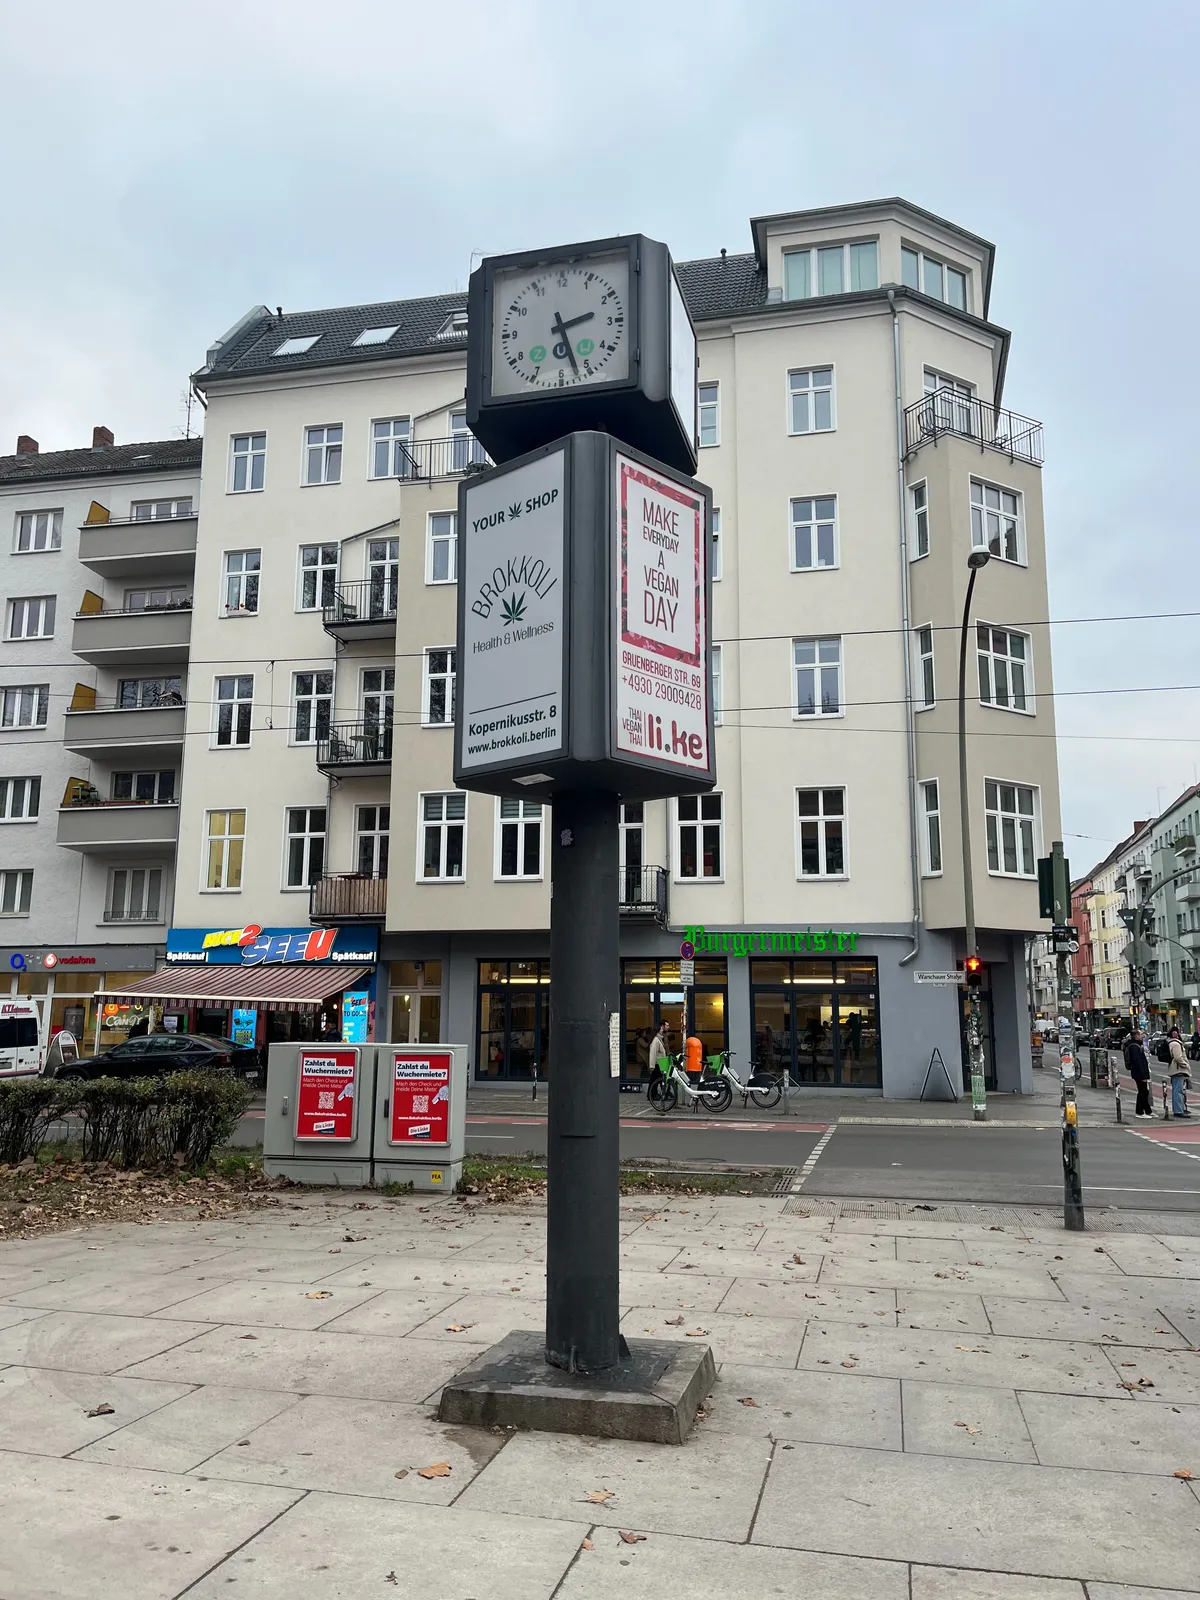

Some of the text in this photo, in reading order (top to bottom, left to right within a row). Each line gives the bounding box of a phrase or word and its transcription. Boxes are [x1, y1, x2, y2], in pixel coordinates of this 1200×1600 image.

[556, 278, 568, 288] 12
[584, 281, 588, 290] 1
[536, 288, 545, 297] 11
[601, 296, 608, 305] 2
[518, 308, 527, 317] 10
[606, 316, 613, 326] 3
[512, 330, 518, 340] 9
[556, 344, 566, 356] U
[600, 340, 606, 349] 4
[518, 352, 524, 360] 8
[534, 349, 543, 360] Z
[584, 359, 590, 368] 5
[534, 366, 540, 376] 7
[558, 369, 564, 378] 6
[472, 488, 558, 533] YOUR SHOP
[643, 497, 680, 538] MAKE
[642, 525, 680, 554] EVERYDAY
[658, 550, 666, 570] A
[471, 555, 558, 620] BROKKOLI
[644, 564, 679, 599] VEGAN
[644, 590, 679, 634] DAY
[473, 622, 554, 654] Health & Wellness
[622, 650, 701, 688] GRUENBERGER STR. 69
[622, 673, 702, 710] +4930 29009428
[468, 704, 557, 736] Kopernikusstr. 8
[628, 706, 642, 722] THAI
[622, 718, 642, 734] VEGAN
[468, 726, 557, 754] www.brokkoli.berlin
[628, 731, 643, 746] THAI
[648, 713, 704, 760] li.ke
[682, 924, 861, 958] Burgermeister
[58, 956, 96, 966] vodafone
[166, 952, 206, 962] Spätkauf
[332, 951, 374, 962] Spätkauf
